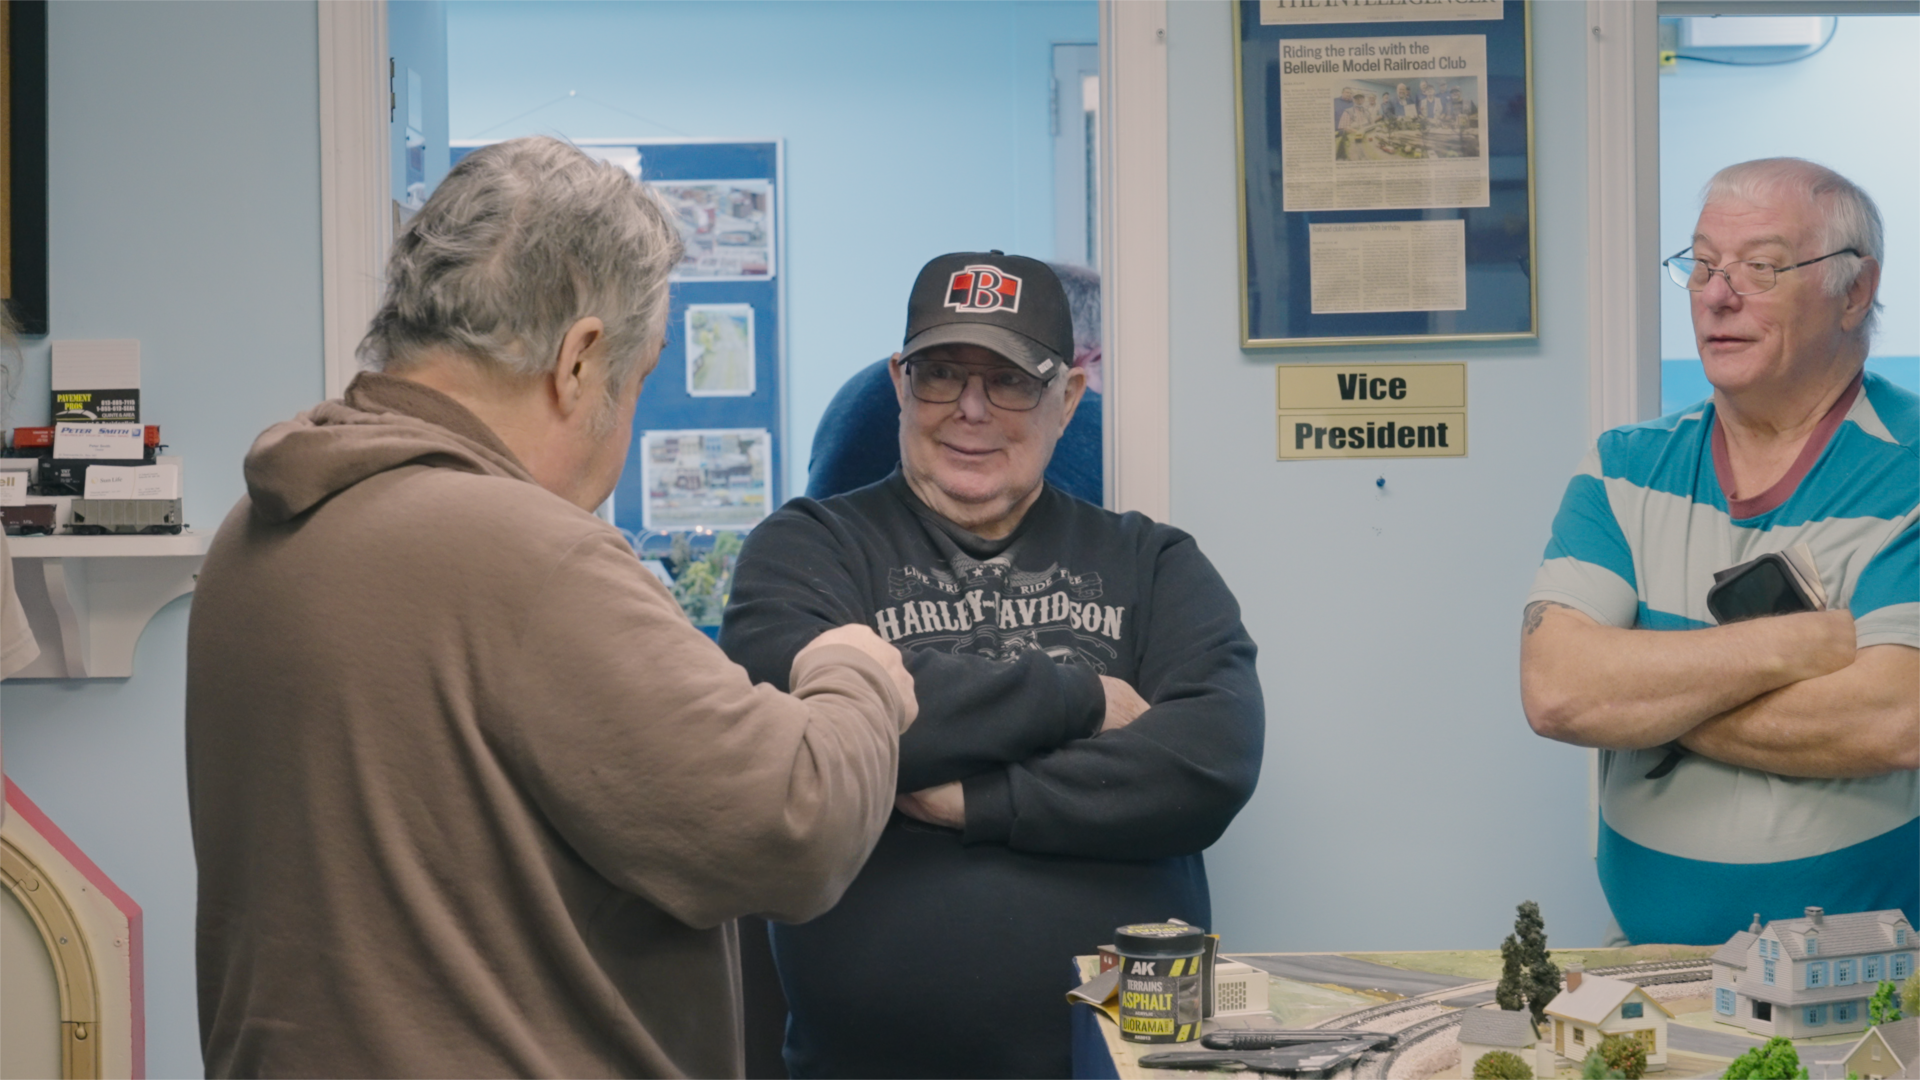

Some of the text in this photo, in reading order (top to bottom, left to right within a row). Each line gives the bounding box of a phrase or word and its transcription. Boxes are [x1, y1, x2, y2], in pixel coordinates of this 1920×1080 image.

[1283, 42, 1429, 60] Riding the rails with the
[1284, 56, 1466, 74] Belleville Model Railroad Club
[961, 267, 1003, 311] B
[1337, 373, 1407, 400] Vice
[57, 393, 92, 402] PAVEMENT
[64, 402, 84, 410] PROS
[98, 427, 129, 435] SMITH
[1295, 421, 1449, 450] President
[904, 566, 930, 584] LIVE
[1020, 577, 1053, 595] RIDE
[1131, 961, 1156, 975] AK
[1127, 979, 1163, 992] TERRAINS
[1122, 991, 1173, 1010] ASPHALT
